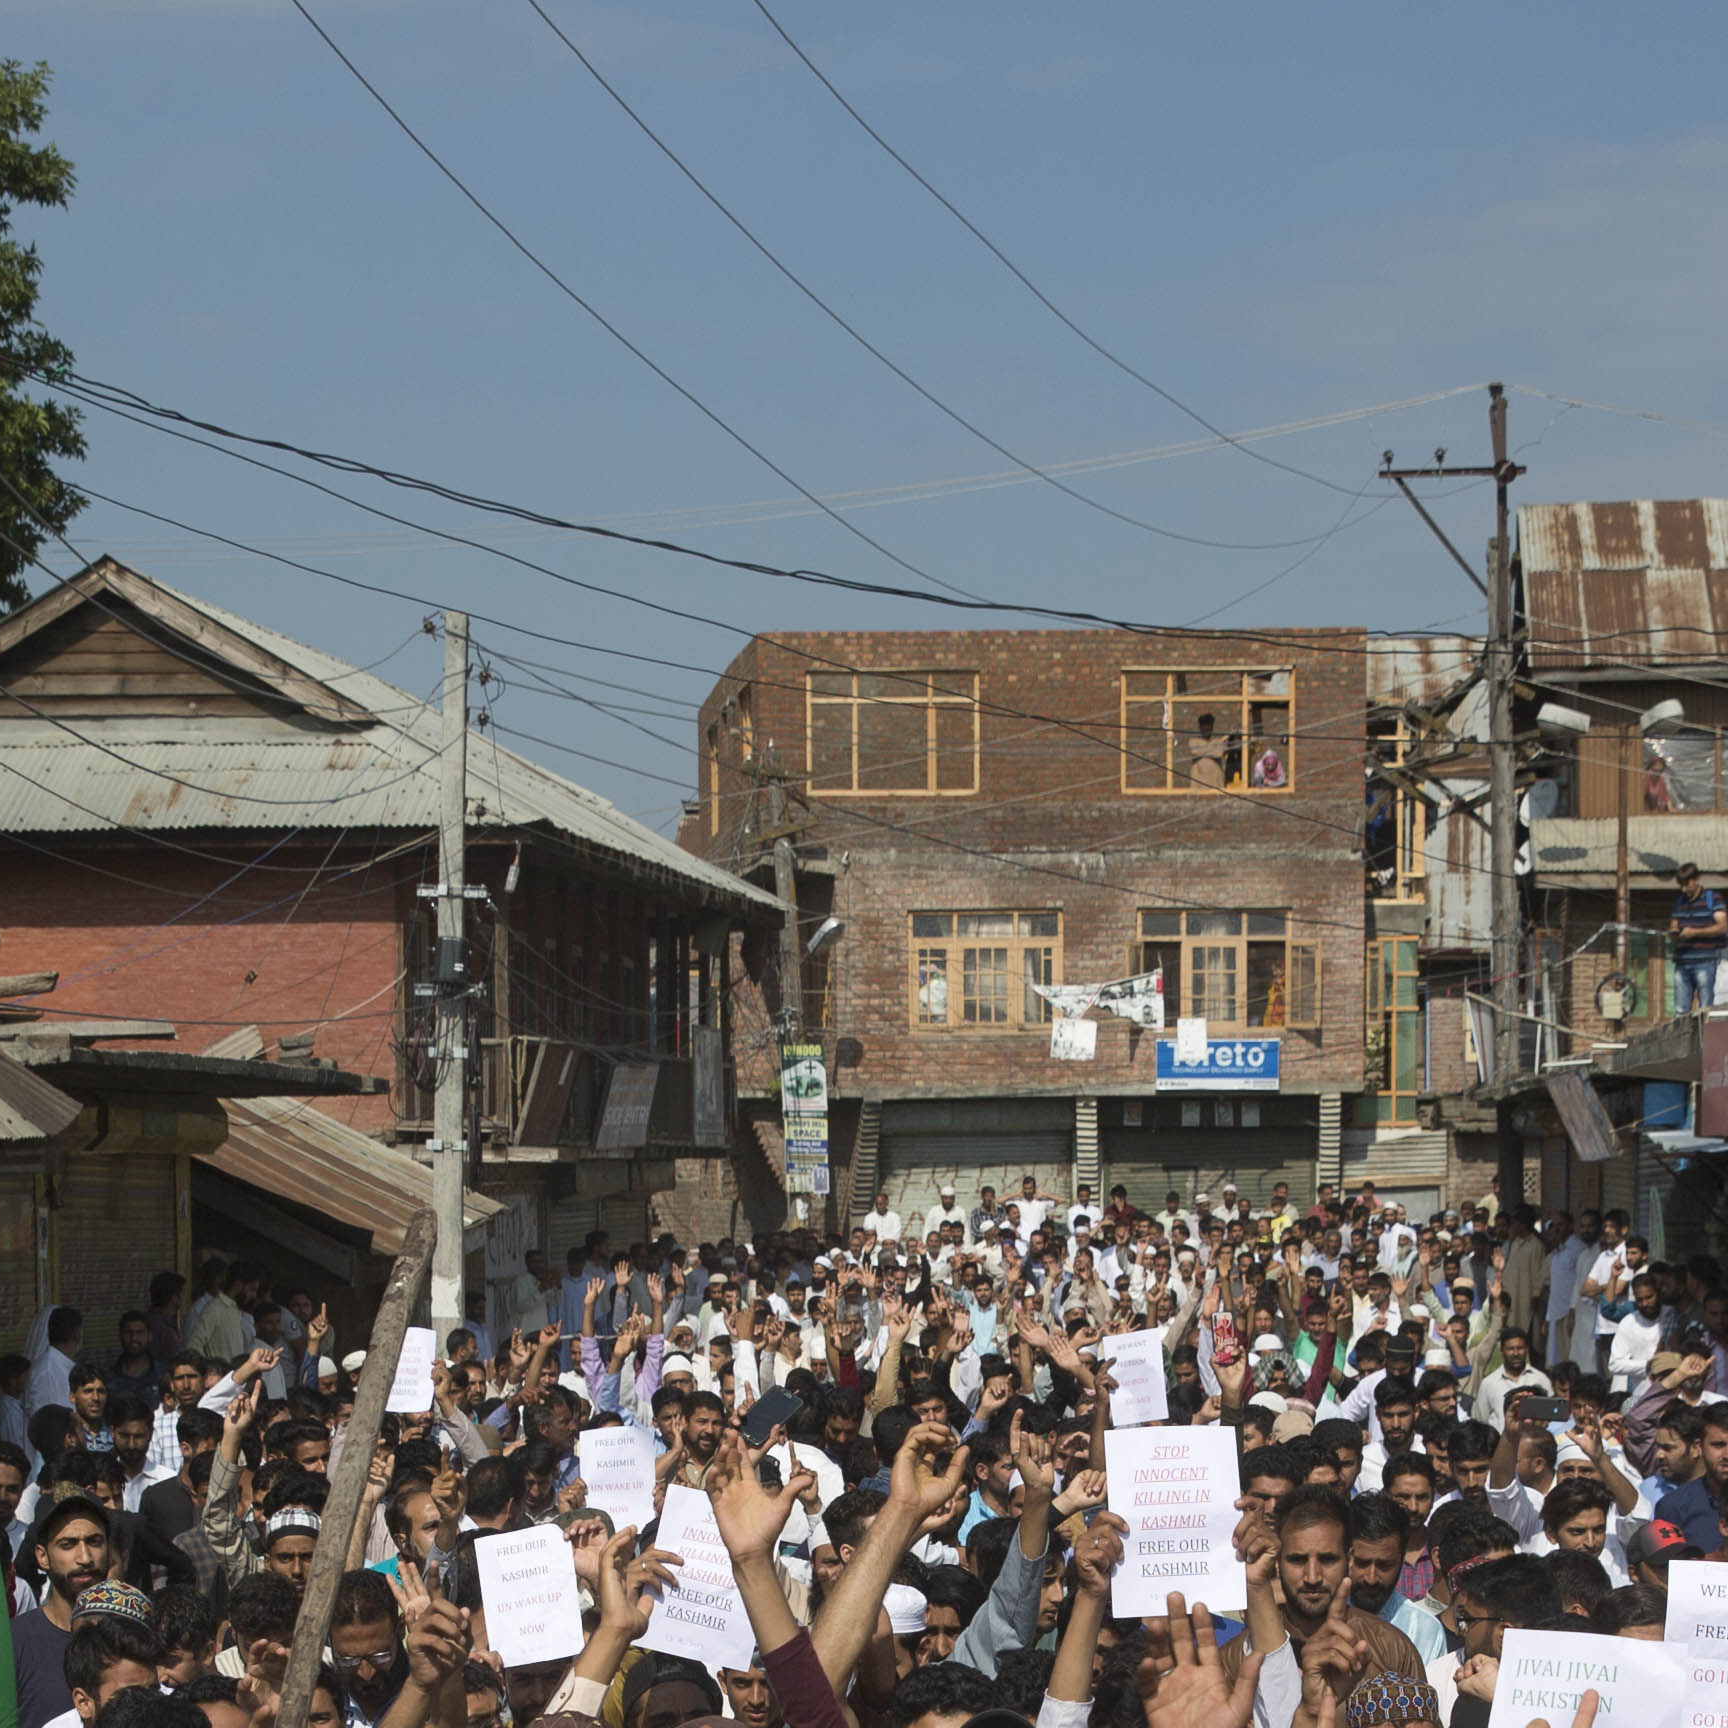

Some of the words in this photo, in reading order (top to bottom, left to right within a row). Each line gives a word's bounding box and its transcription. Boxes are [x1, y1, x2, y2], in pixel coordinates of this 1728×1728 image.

[1167, 1042, 1265, 1067] Treto
[1152, 1446, 1190, 1459] STOP
[1134, 1467, 1209, 1482] INNOCENT
[1134, 1490, 1191, 1504] KILLING
[1194, 1489, 1212, 1502] IN
[1141, 1514, 1207, 1529] KASHMIR
[497, 1544, 523, 1557] FREE
[525, 1539, 547, 1552] OUR
[1138, 1541, 1174, 1554] FREE
[1179, 1539, 1210, 1552] OUR
[501, 1565, 550, 1583] KASHMIR
[1141, 1562, 1210, 1576] KASHMIR
[1701, 1584, 1726, 1598] WE
[514, 1594, 545, 1609] WAKE
[547, 1591, 562, 1602] UP
[705, 1594, 733, 1613] OUR
[665, 1605, 726, 1632] KASHMIR
[519, 1623, 545, 1636] NOW
[1516, 1659, 1561, 1678] JIVAI
[1567, 1661, 1618, 1683] JIVAI
[1693, 1668, 1715, 1683] GO
[1511, 1689, 1613, 1713] PAKISTN
[1693, 1713, 1714, 1727] GO
